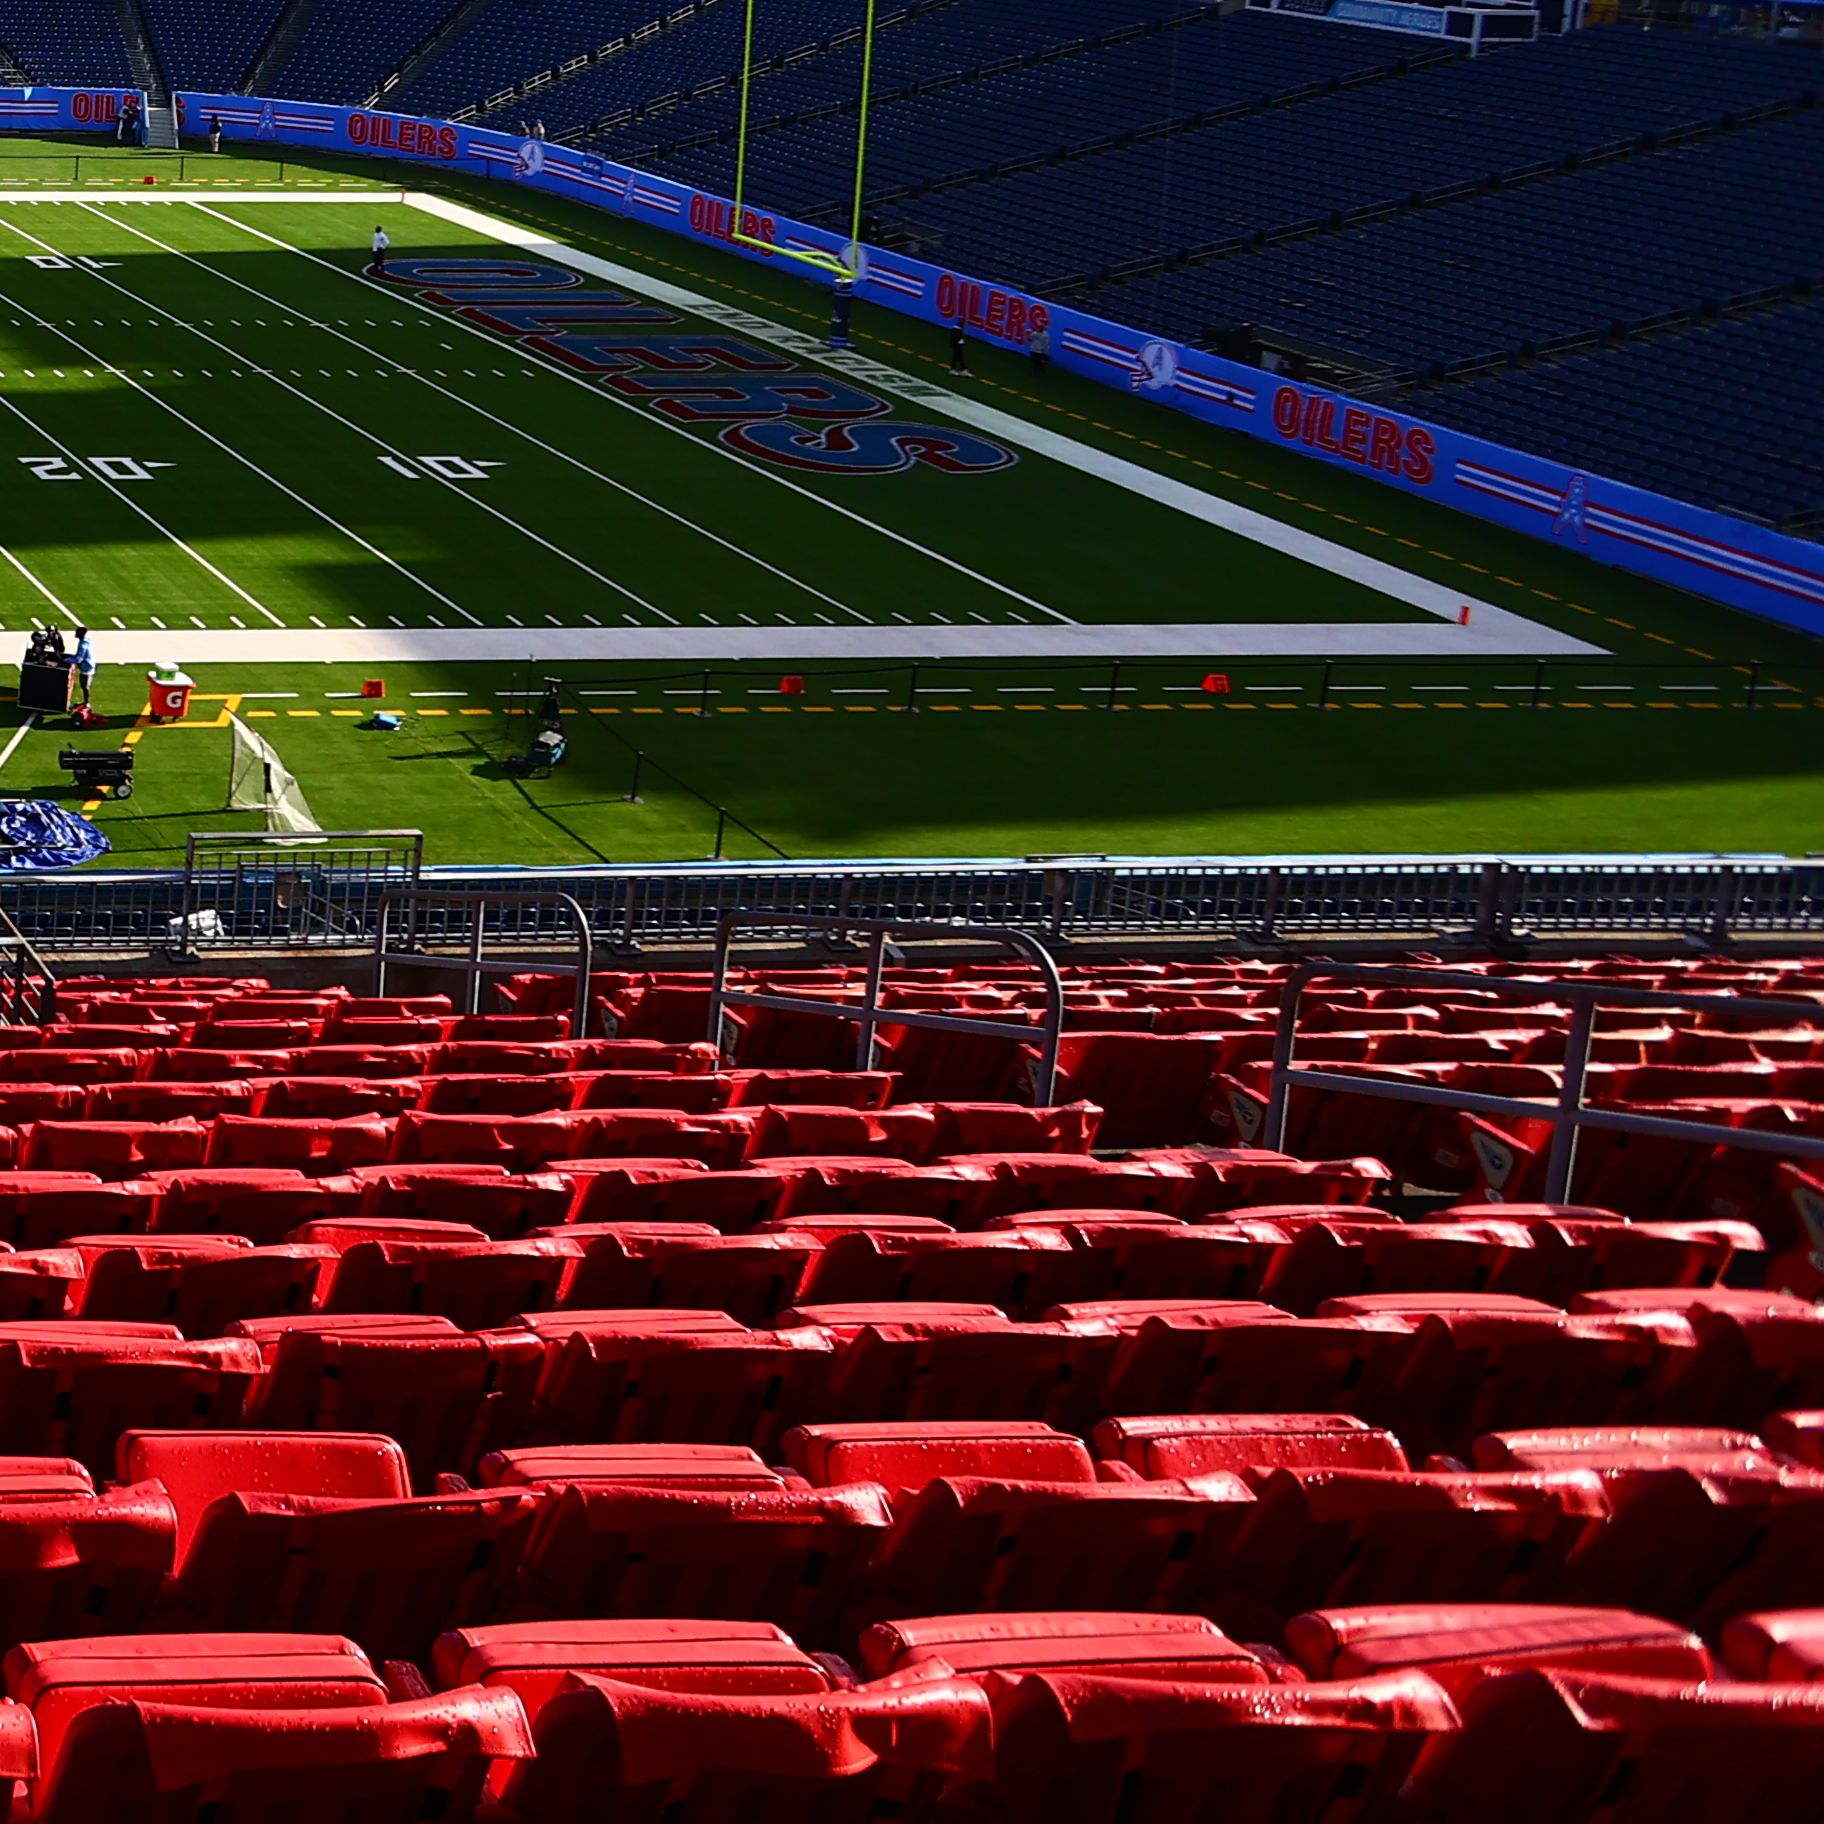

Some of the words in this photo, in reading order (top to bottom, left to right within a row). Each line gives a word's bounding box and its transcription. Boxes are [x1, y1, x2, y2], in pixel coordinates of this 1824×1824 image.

[346, 112, 457, 158] OILERS
[936, 272, 1049, 344] OILERS
[363, 256, 1022, 476] OILERS
[1271, 385, 1435, 485] OILERS
[24, 455, 155, 481] 20
[377, 455, 490, 479] 10
[166, 691, 183, 708] G
